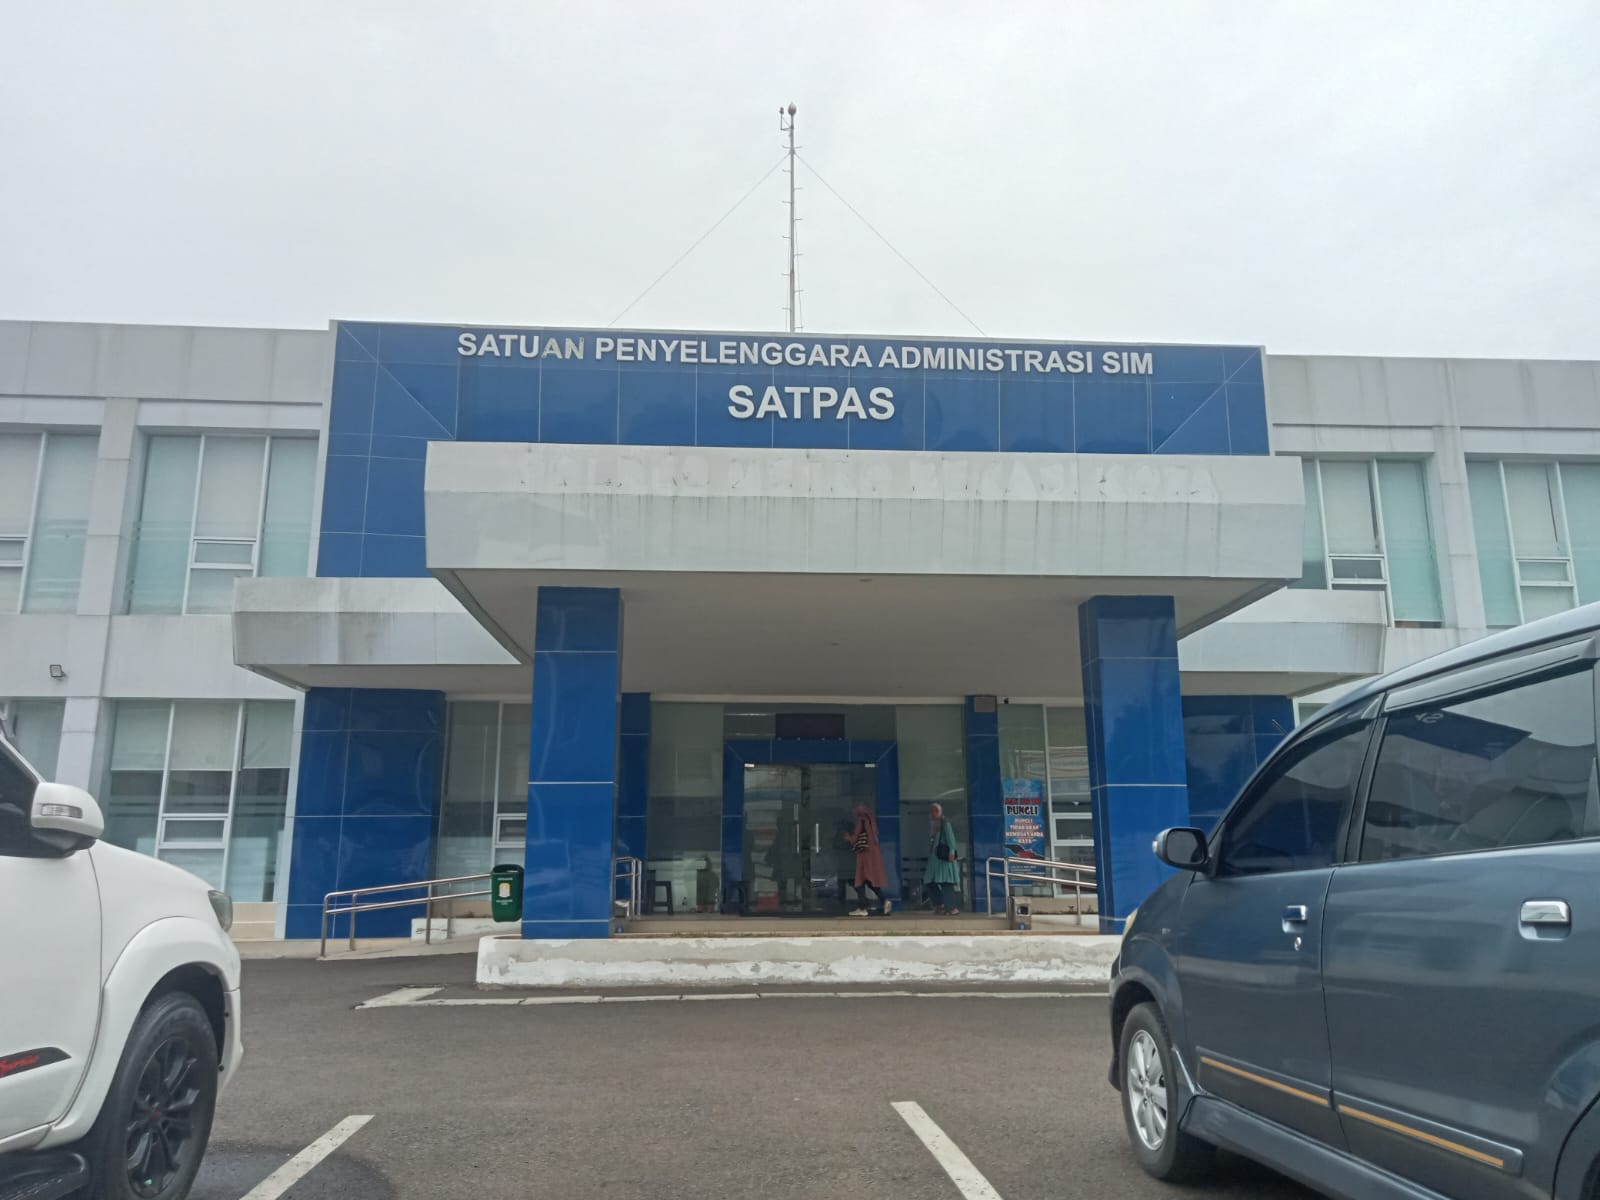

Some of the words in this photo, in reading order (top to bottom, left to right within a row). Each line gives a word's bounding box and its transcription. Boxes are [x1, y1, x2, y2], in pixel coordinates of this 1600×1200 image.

[457, 333, 584, 360] SATUAN
[595, 337, 873, 368] PENYELENGGARA
[878, 346, 1093, 374] ADMINISTRASI
[1102, 351, 1154, 375] SIM
[728, 385, 895, 420] SATPAS
[1006, 805, 1038, 815] PUNGLI
